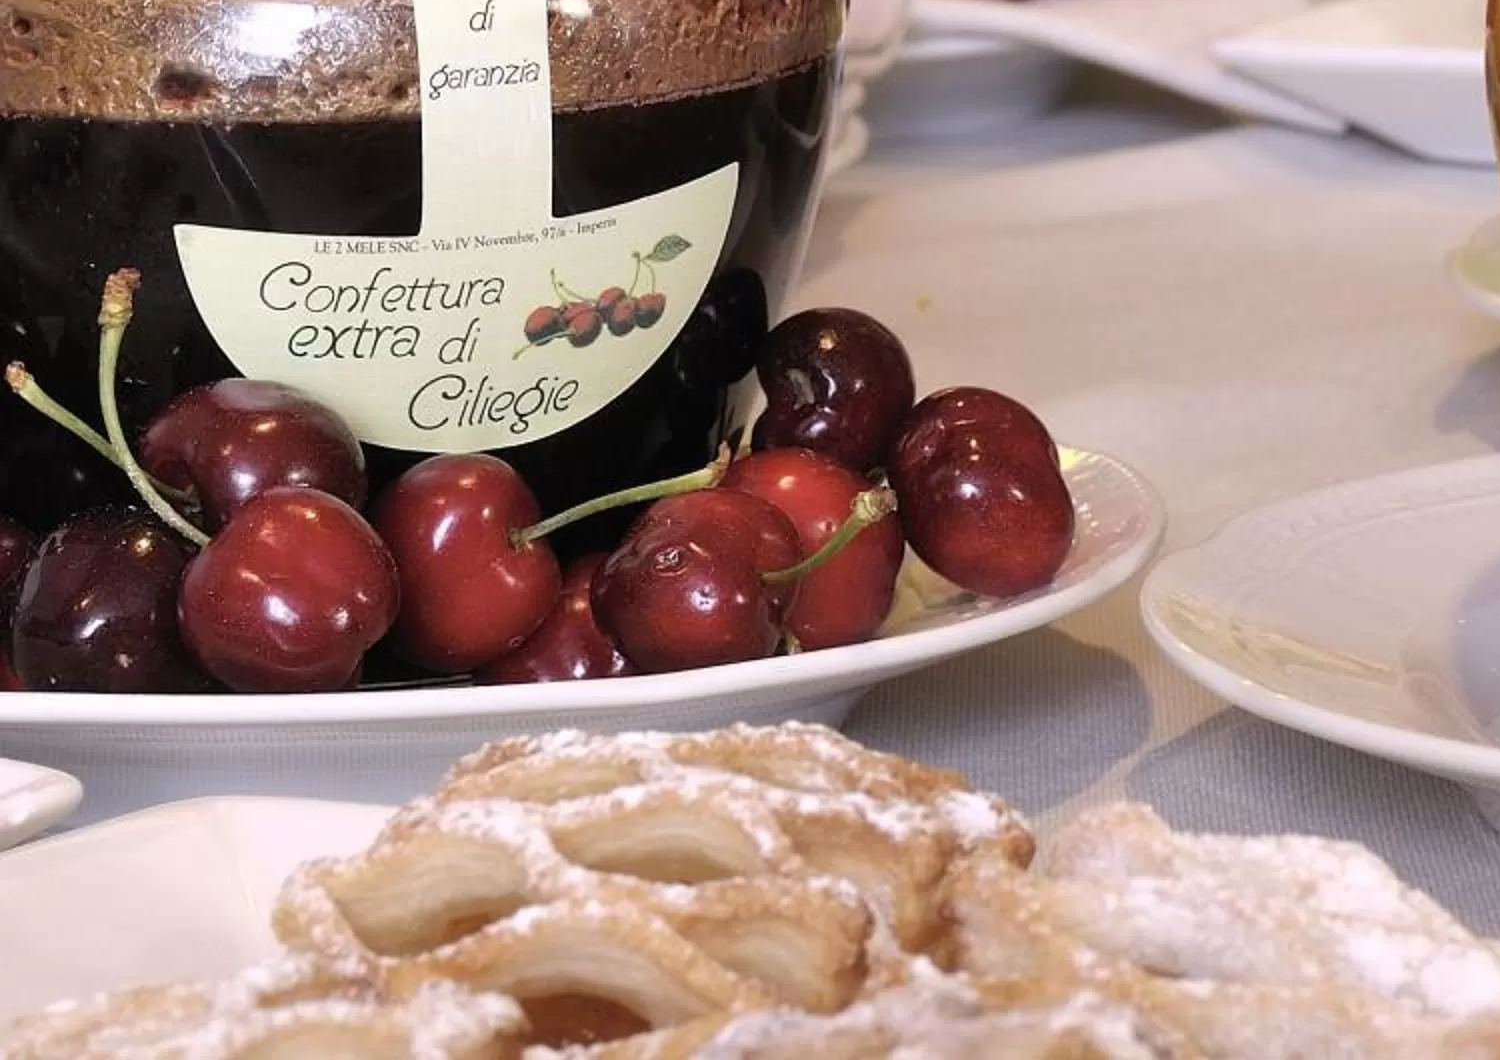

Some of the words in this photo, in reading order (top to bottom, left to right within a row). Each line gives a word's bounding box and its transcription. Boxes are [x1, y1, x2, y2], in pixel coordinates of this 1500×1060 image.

[428, 58, 542, 100] garanzia
[314, 241, 332, 253] LE
[335, 241, 343, 254] 2
[346, 241, 385, 253] MELE
[388, 241, 419, 253] SNC
[432, 239, 452, 251] Via
[455, 237, 471, 250] IV
[260, 262, 505, 313] Confettura
[288, 319, 421, 360] extra
[438, 318, 481, 365] di
[408, 374, 579, 434] Ciliegie
